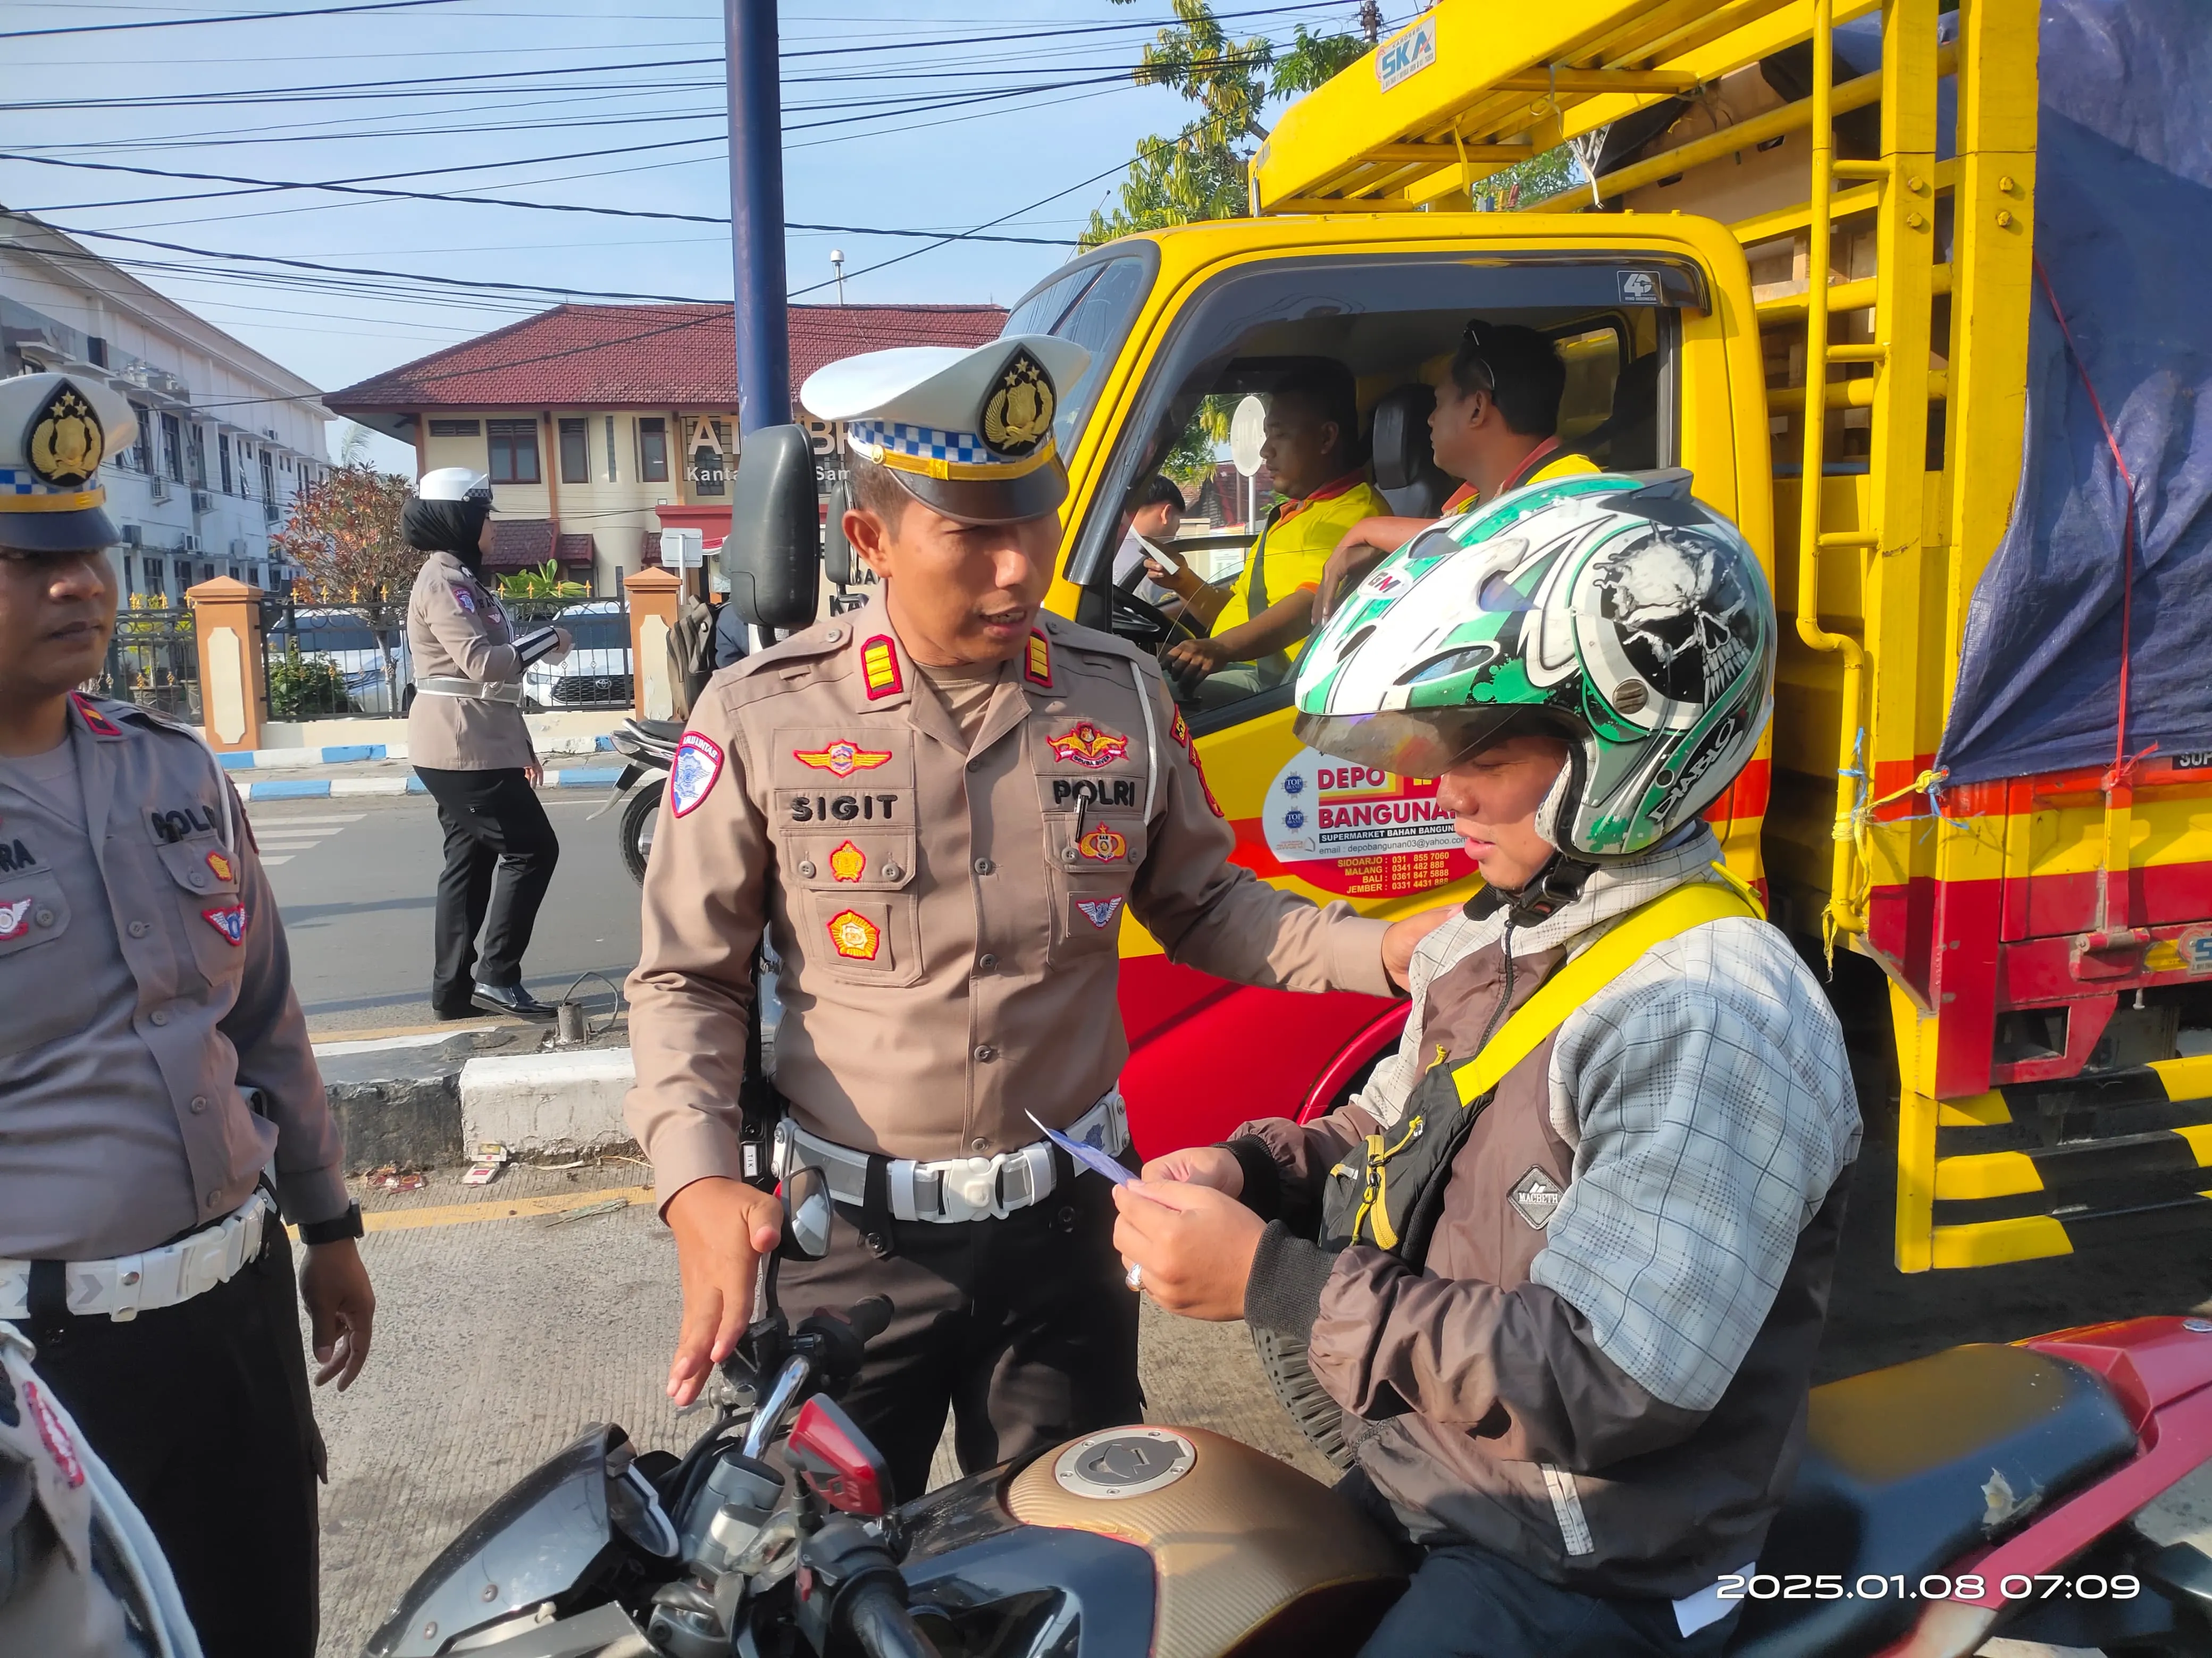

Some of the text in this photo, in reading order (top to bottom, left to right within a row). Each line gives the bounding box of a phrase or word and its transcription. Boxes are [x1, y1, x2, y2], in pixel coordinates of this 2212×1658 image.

[1382, 30, 1431, 80] SKA
[1073, 755, 1111, 765] SCUBA DIVER
[1648, 718, 1736, 822] DIABLO
[1318, 767, 1385, 790] DEPO
[1053, 779, 1135, 807] POLRI
[791, 795, 898, 822] SIGIT
[1319, 801, 1455, 829] BANGUNA
[1321, 830, 1385, 841] SUPERMARKET
[1387, 828, 1416, 837] BAHAN
[1319, 846, 1340, 854] email
[1337, 856, 1382, 867] SIDOARJO
[1392, 855, 1406, 864] 031
[1430, 852, 1449, 860] 7060
[1345, 866, 1382, 876] MALANG
[1392, 864, 1410, 872] 0341
[1413, 862, 1428, 870] 482
[1392, 872, 1410, 881] 0361
[1413, 870, 1428, 879] 847
[1346, 883, 1382, 894] JEMBER
[1392, 881, 1410, 890] 0331
[1413, 879, 1432, 888] 4431
[1434, 878, 1449, 886] 888
[1519, 1192, 1559, 1203] MACBETH
